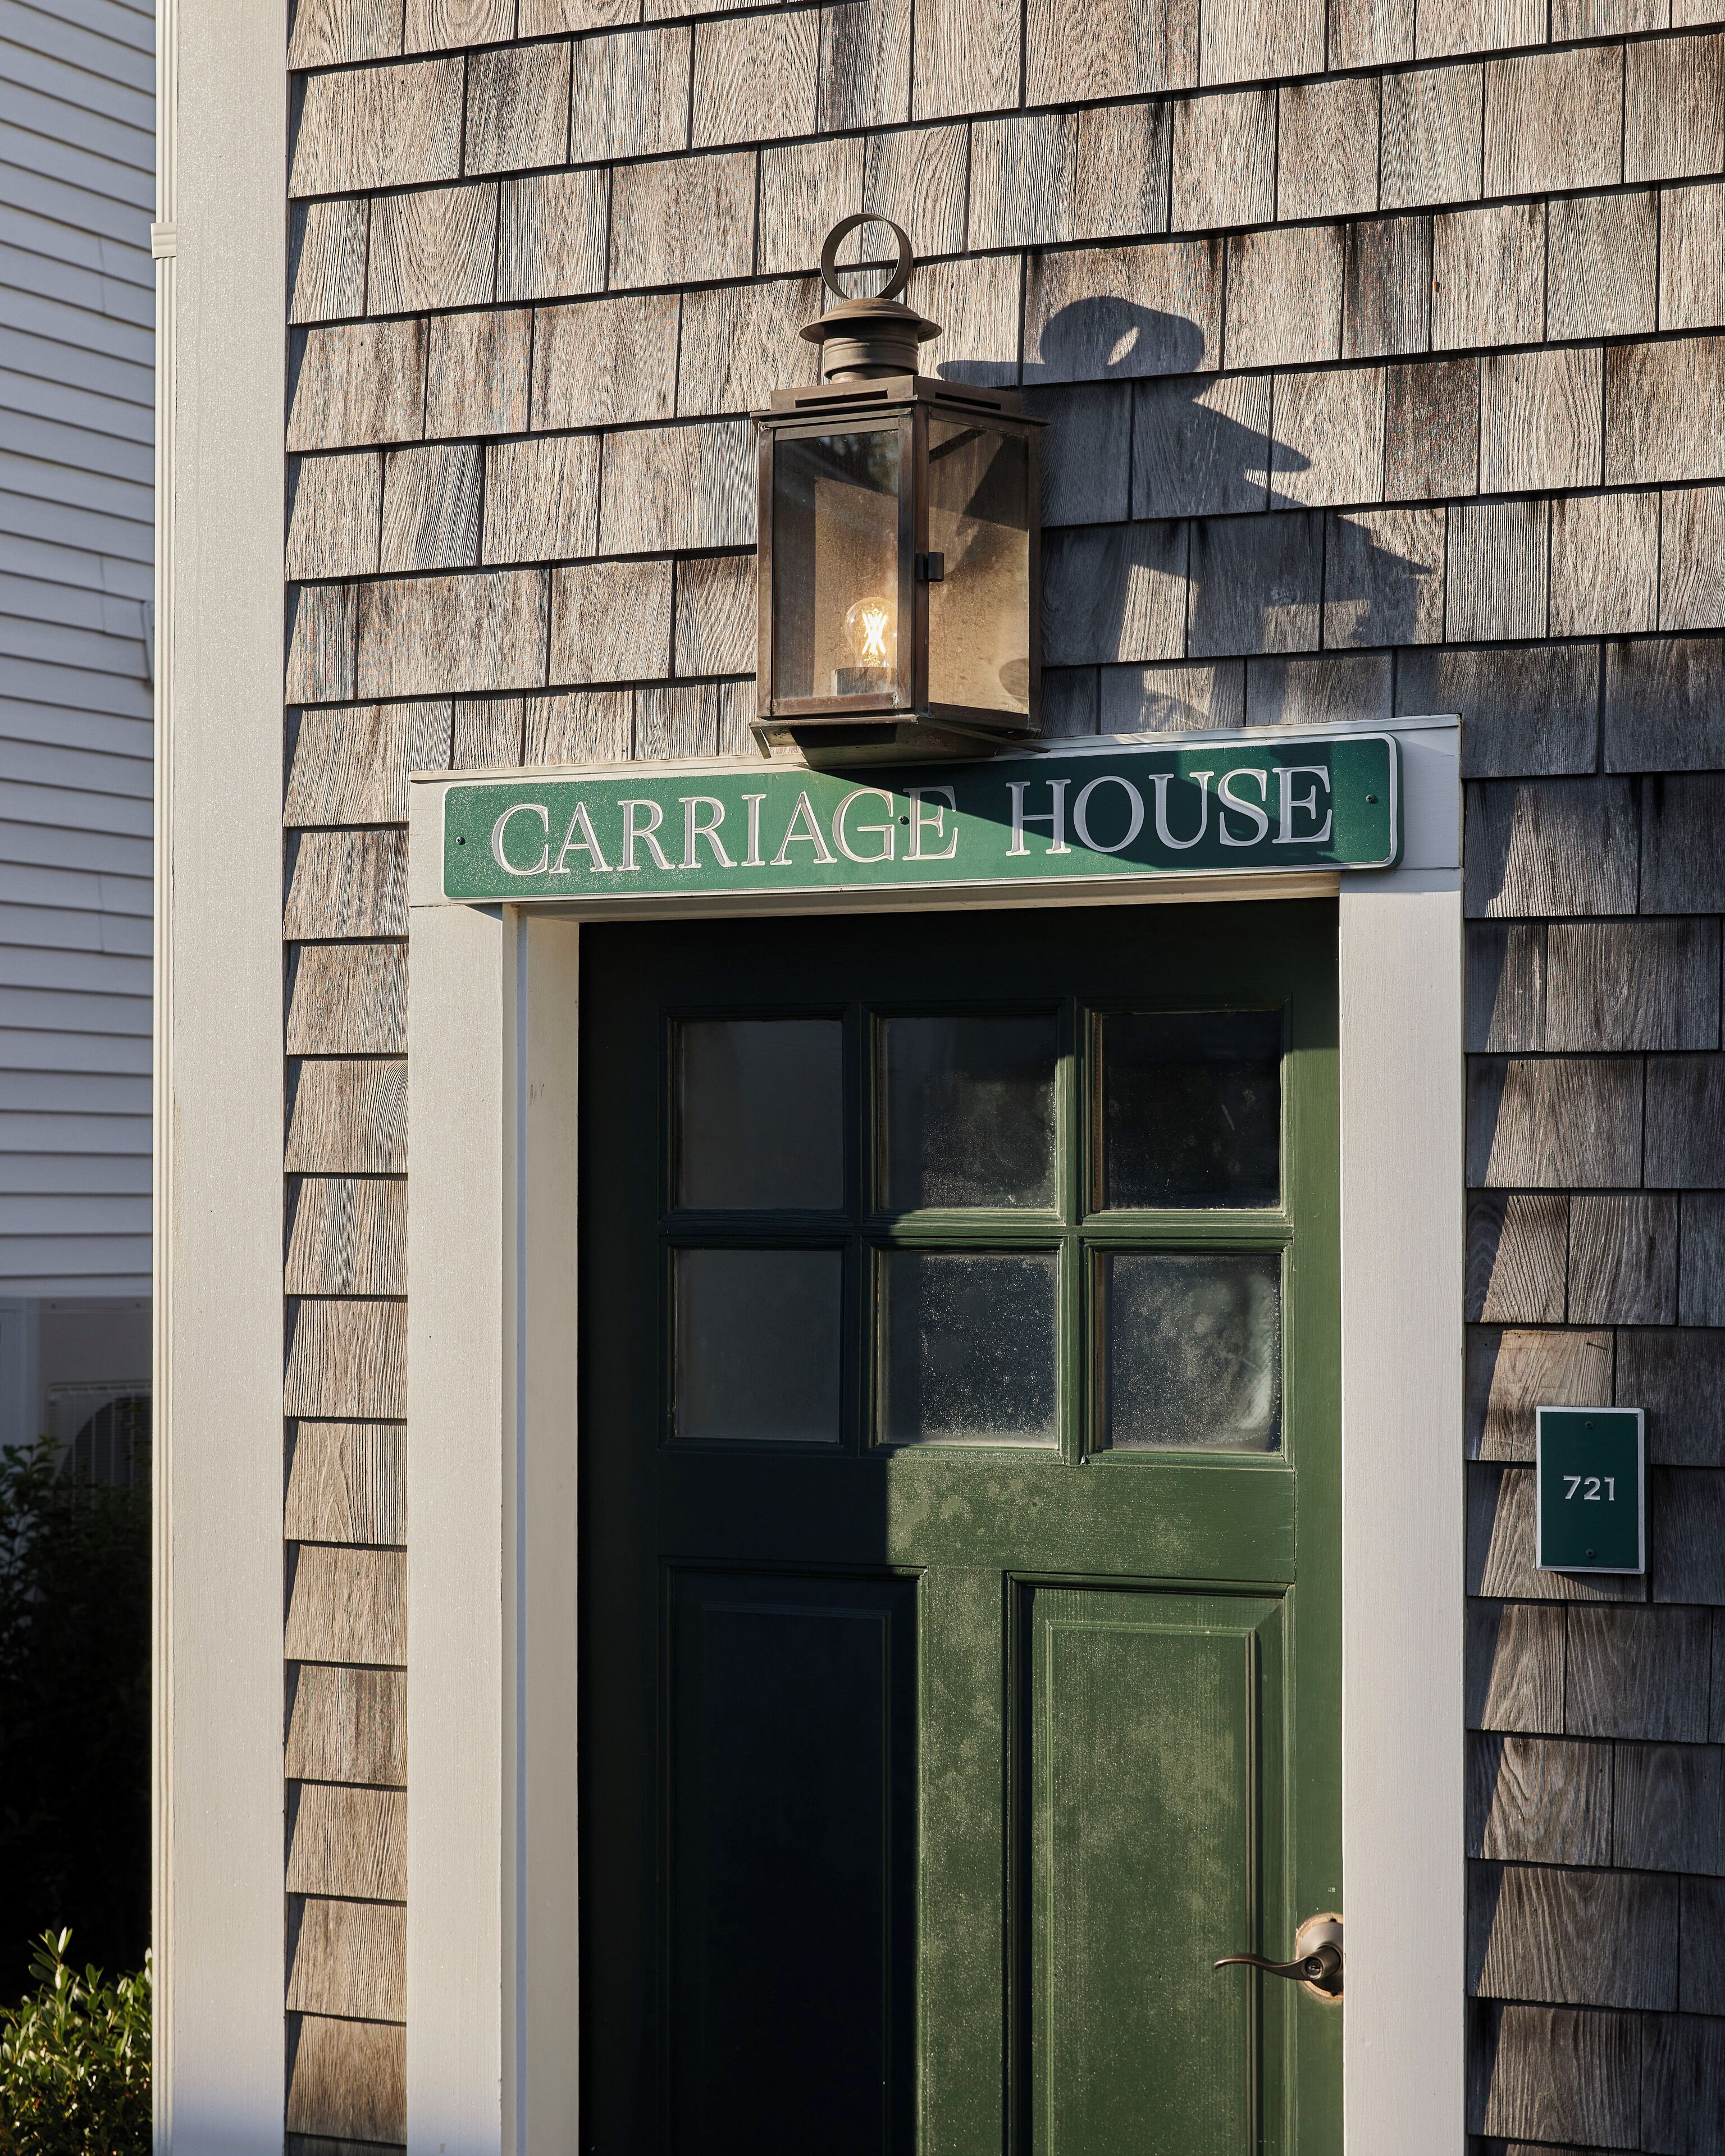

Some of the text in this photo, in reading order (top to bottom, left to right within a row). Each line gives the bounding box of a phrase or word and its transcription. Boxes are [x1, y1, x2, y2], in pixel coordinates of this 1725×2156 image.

[491, 765, 1332, 876] CARRIAGE HOUSE
[1563, 1475, 1614, 1501] 721
